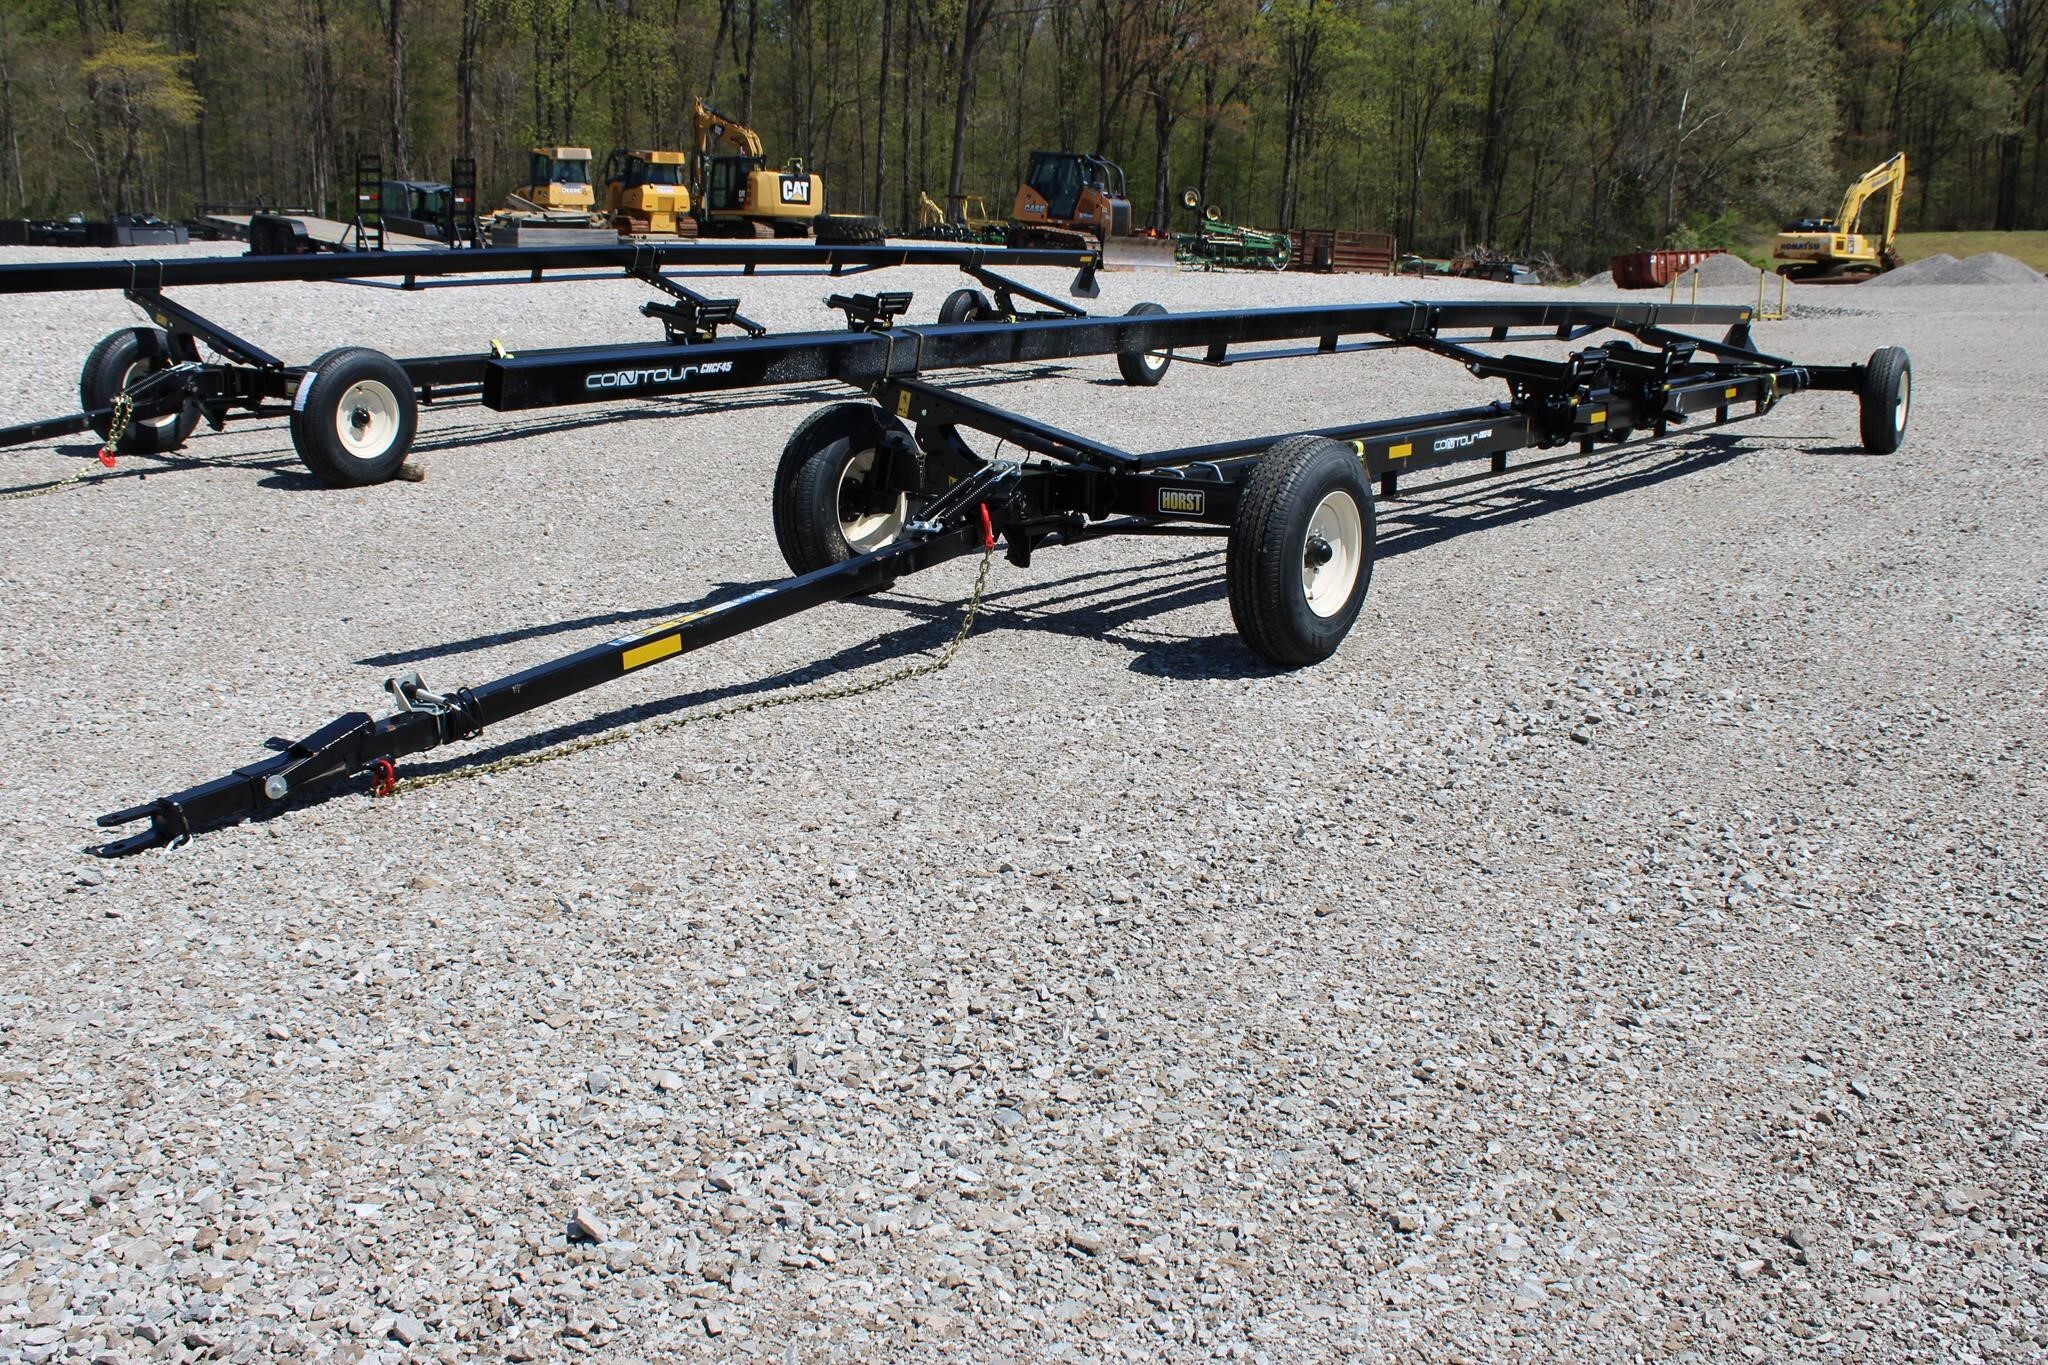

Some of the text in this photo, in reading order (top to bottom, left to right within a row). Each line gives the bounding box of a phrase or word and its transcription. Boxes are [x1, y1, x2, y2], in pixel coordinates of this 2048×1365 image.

[782, 180, 809, 201] CAT
[1024, 204, 1045, 213] CASE
[1781, 241, 1820, 251] KOMATSU
[586, 361, 733, 388] CONTOUR CHCF45
[1162, 491, 1202, 512] HORST
